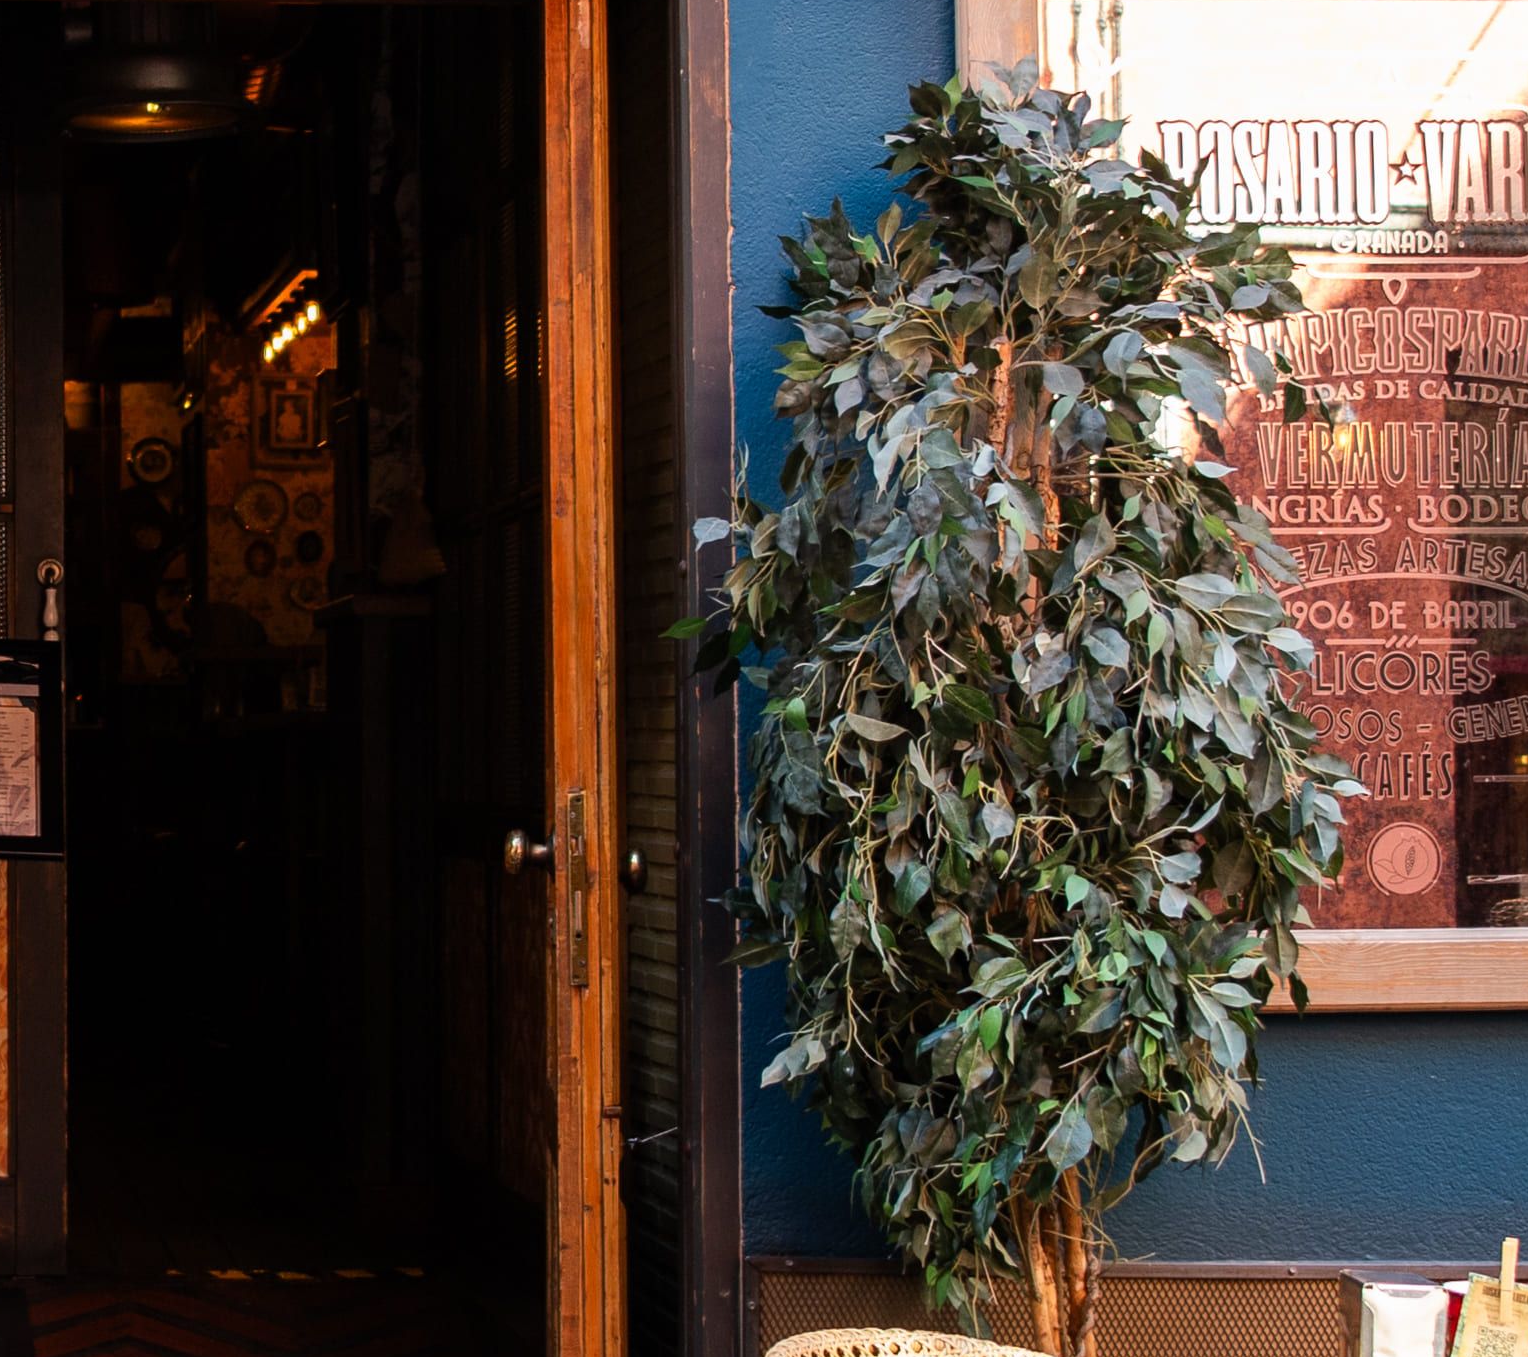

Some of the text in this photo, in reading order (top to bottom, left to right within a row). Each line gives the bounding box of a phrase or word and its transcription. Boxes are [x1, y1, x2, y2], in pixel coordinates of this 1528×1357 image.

[1156, 120, 1390, 224] ROSARIO
[1332, 229, 1449, 254] GRANADA
[1256, 380, 1364, 413] BEIDAS
[1374, 380, 1409, 399] DE
[1234, 489, 1384, 523] NGRÍAS
[1368, 600, 1406, 629] DE
[1423, 601, 1516, 630] BARRIL
[1311, 650, 1493, 695] LICORES
[1352, 742, 1453, 801] CAFÉS
